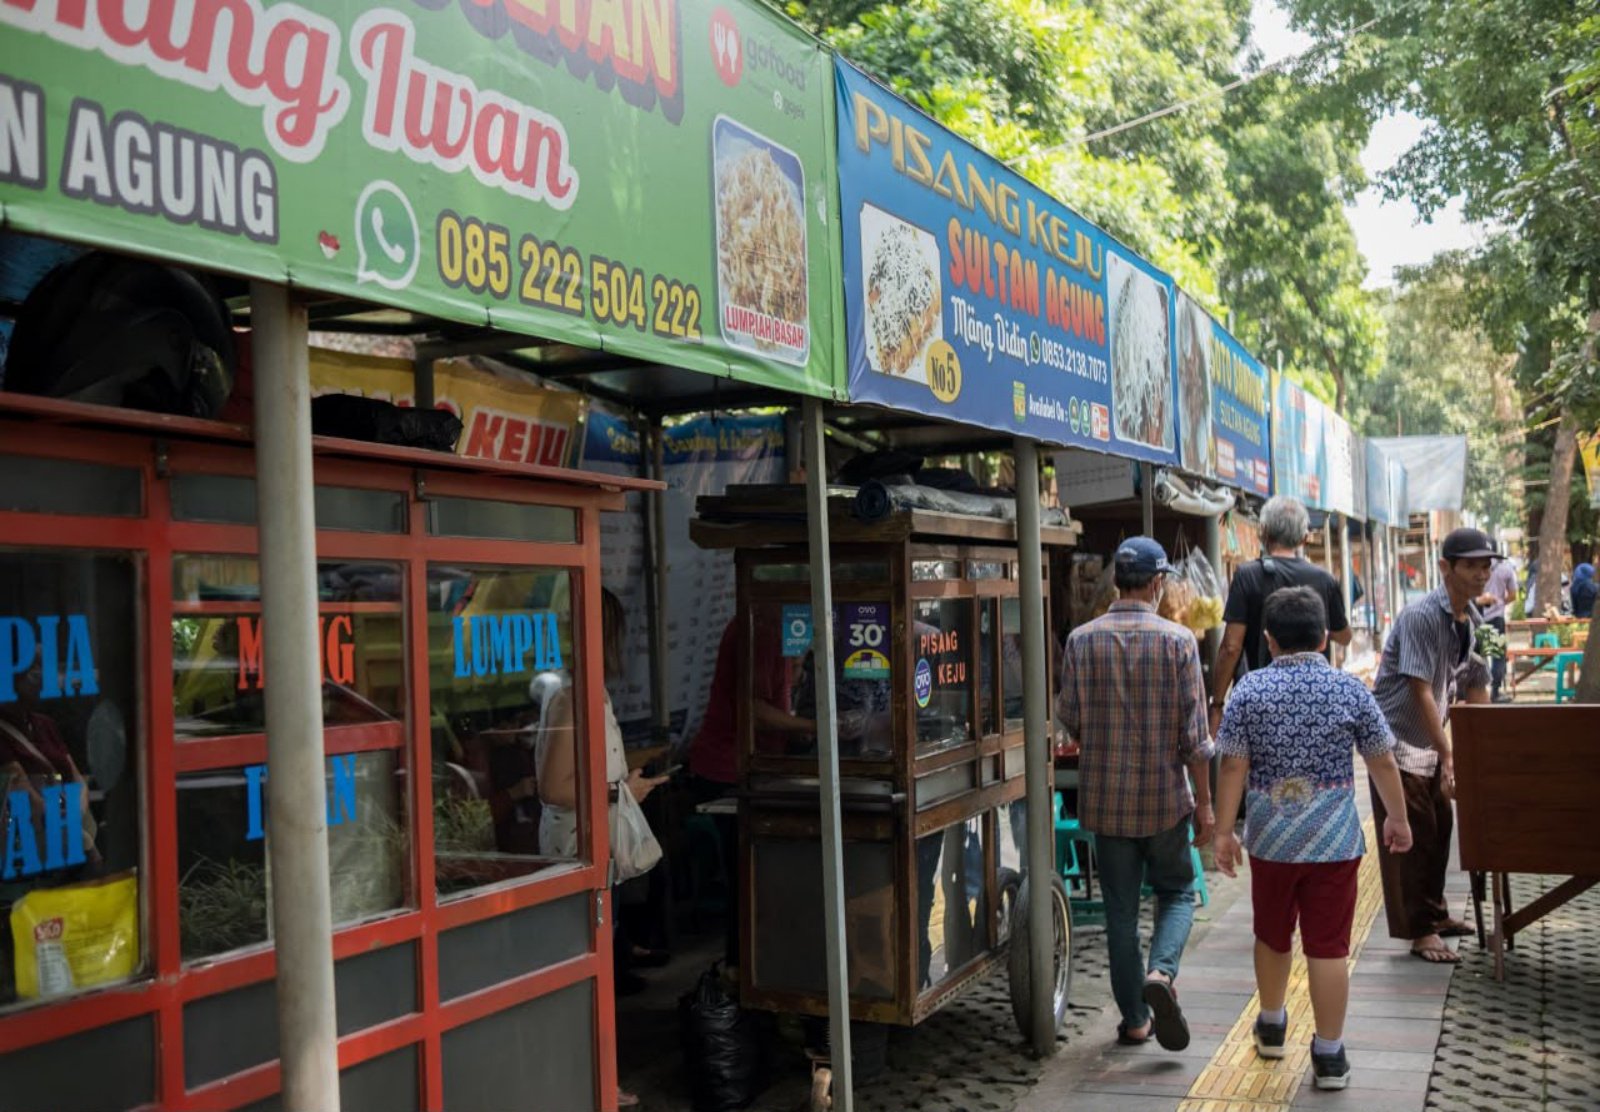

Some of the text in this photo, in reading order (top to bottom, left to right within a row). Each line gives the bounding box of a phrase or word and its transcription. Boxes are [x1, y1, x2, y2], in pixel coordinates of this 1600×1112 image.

[63, 101, 277, 242] AGUNG
[357, 17, 575, 202] Iwan
[853, 91, 1103, 281] PISANG KEJU
[438, 212, 702, 339] 085 222 504 222
[725, 304, 804, 349] LUMPIAH BASAH
[948, 216, 1106, 347] SULTAN AGUNG
[452, 612, 563, 679] LUMPIA
[920, 630, 958, 656] PISANG
[938, 661, 966, 686] KEJU
